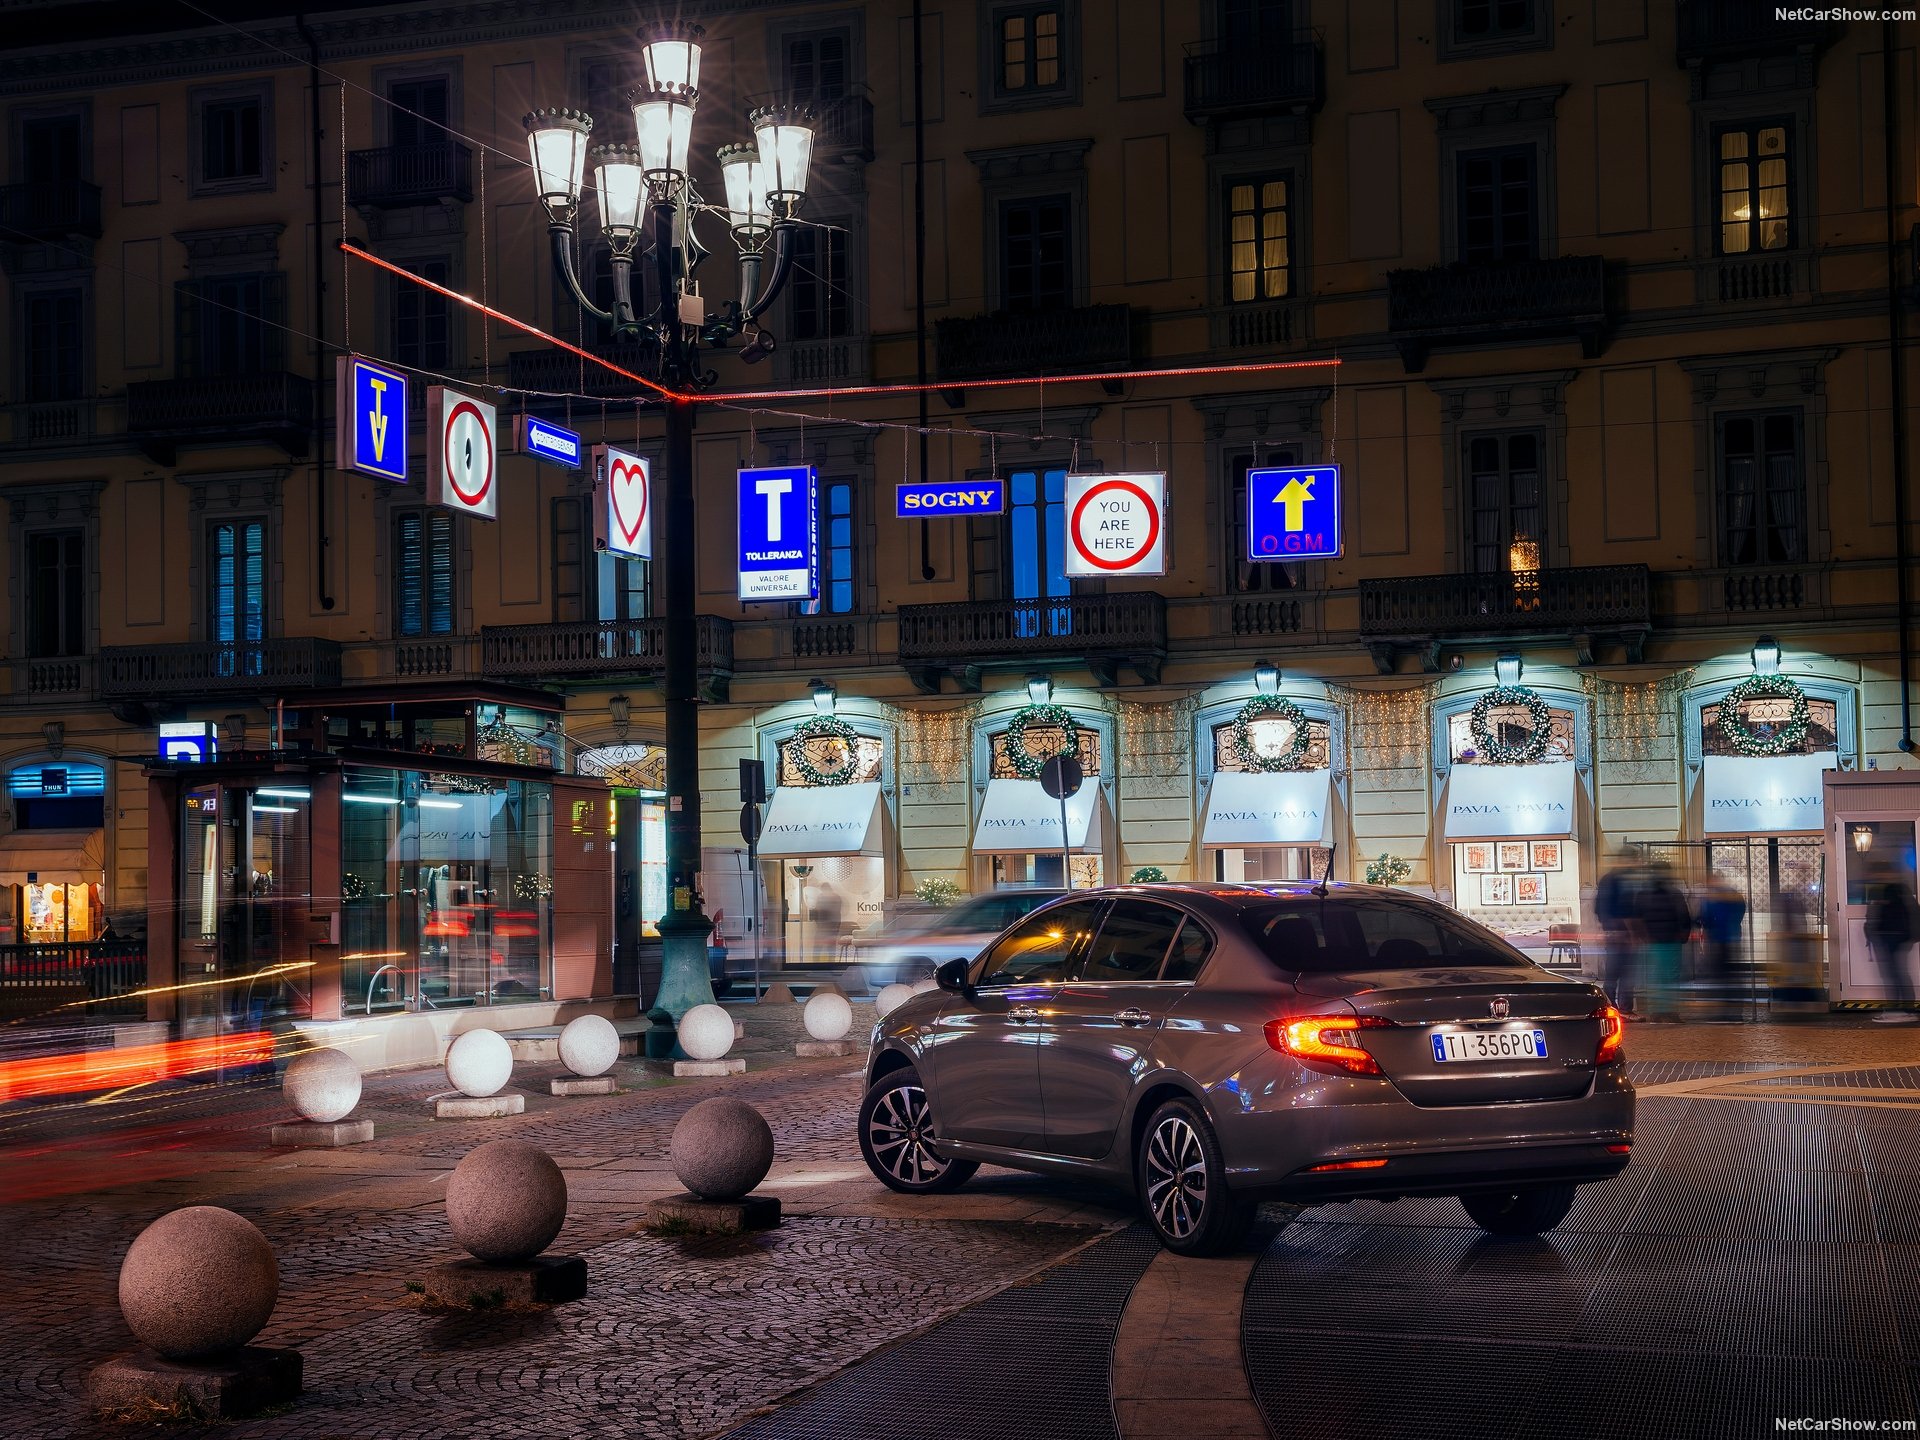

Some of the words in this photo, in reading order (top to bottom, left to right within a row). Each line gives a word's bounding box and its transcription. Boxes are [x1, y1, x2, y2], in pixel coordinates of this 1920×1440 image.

[904, 490, 995, 509] SOGNY
[755, 478, 793, 542] T
[1099, 501, 1131, 513] YOU
[1099, 519, 1130, 531] ARE
[1094, 537, 1135, 549] HERE
[745, 550, 803, 561] TOLLERANZA
[759, 574, 789, 582] VALORE
[750, 583, 798, 592] UNIVERSALE
[1453, 805, 1500, 814] PAVIA
[1517, 803, 1565, 812] PAVIA
[1712, 799, 1762, 808] PAVIA
[1213, 812, 1258, 821] PAVIA
[1273, 810, 1318, 819] PAVIA
[768, 824, 808, 833] PAVIA
[821, 822, 862, 831] PAVIA
[984, 818, 1026, 827] PAVIA
[1495, 1003, 1506, 1014] FIAT
[1445, 1036, 1468, 1058] TI
